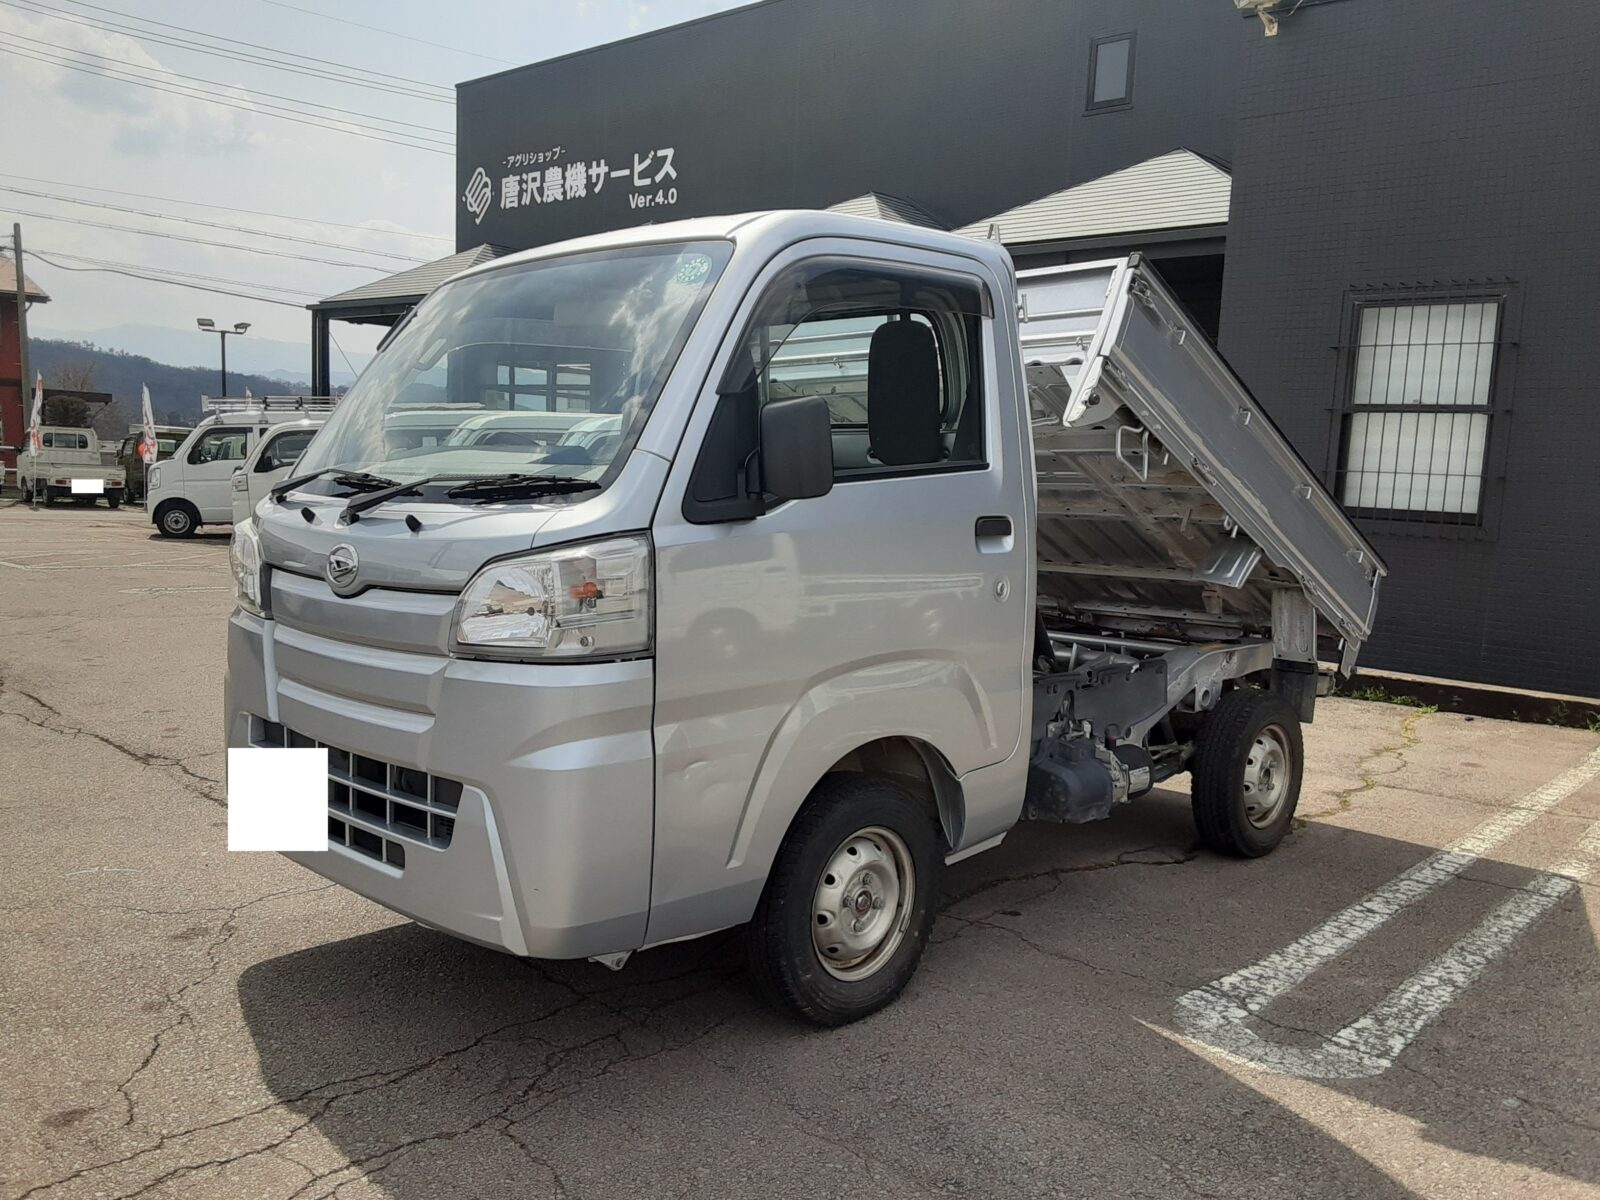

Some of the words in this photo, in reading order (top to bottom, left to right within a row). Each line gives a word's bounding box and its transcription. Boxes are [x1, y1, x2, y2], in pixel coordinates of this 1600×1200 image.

[500, 147, 678, 210] 唐沢農機サービス
[629, 188, 678, 209] Ver.4.0
